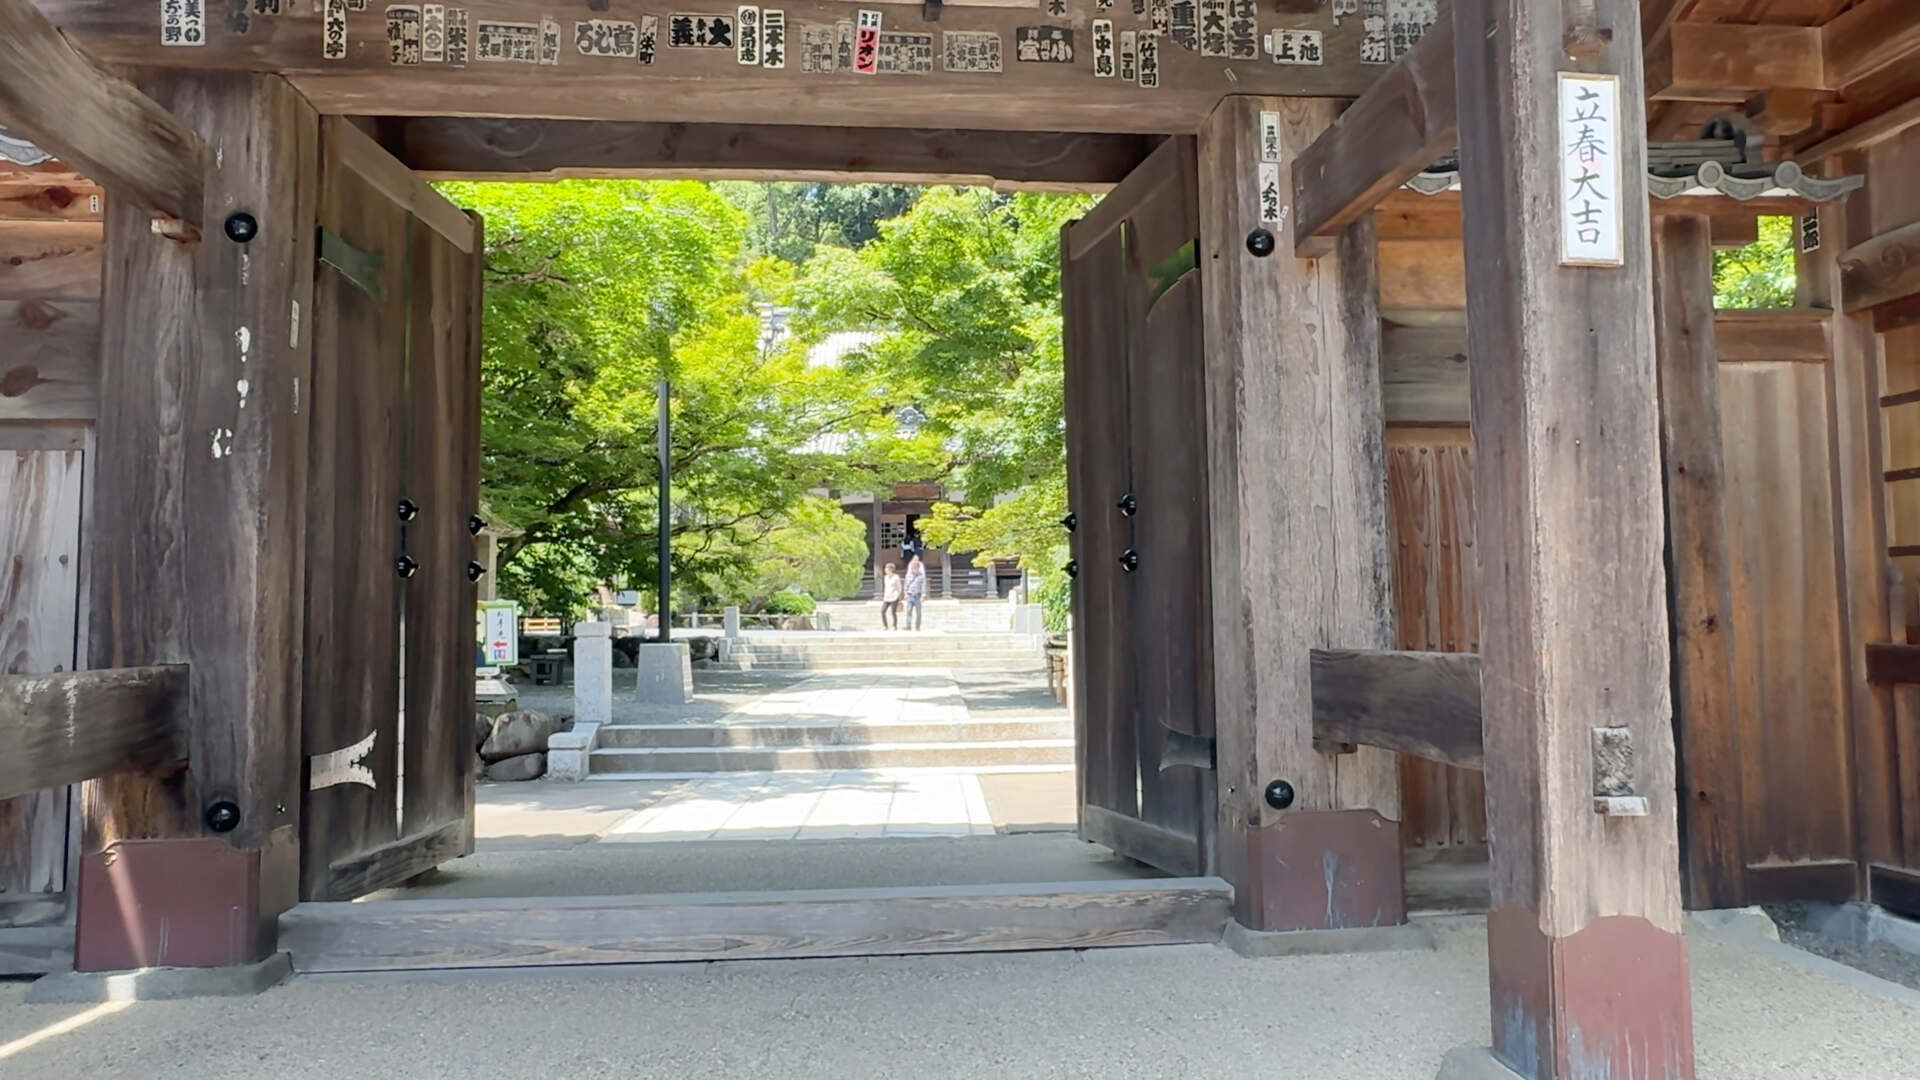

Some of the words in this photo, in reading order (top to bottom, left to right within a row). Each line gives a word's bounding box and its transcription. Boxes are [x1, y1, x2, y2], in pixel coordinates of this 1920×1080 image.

[859, 30, 875, 69] リオン
[1095, 35, 1113, 75] 中島
[1568, 86, 1608, 245] 立春大吉
